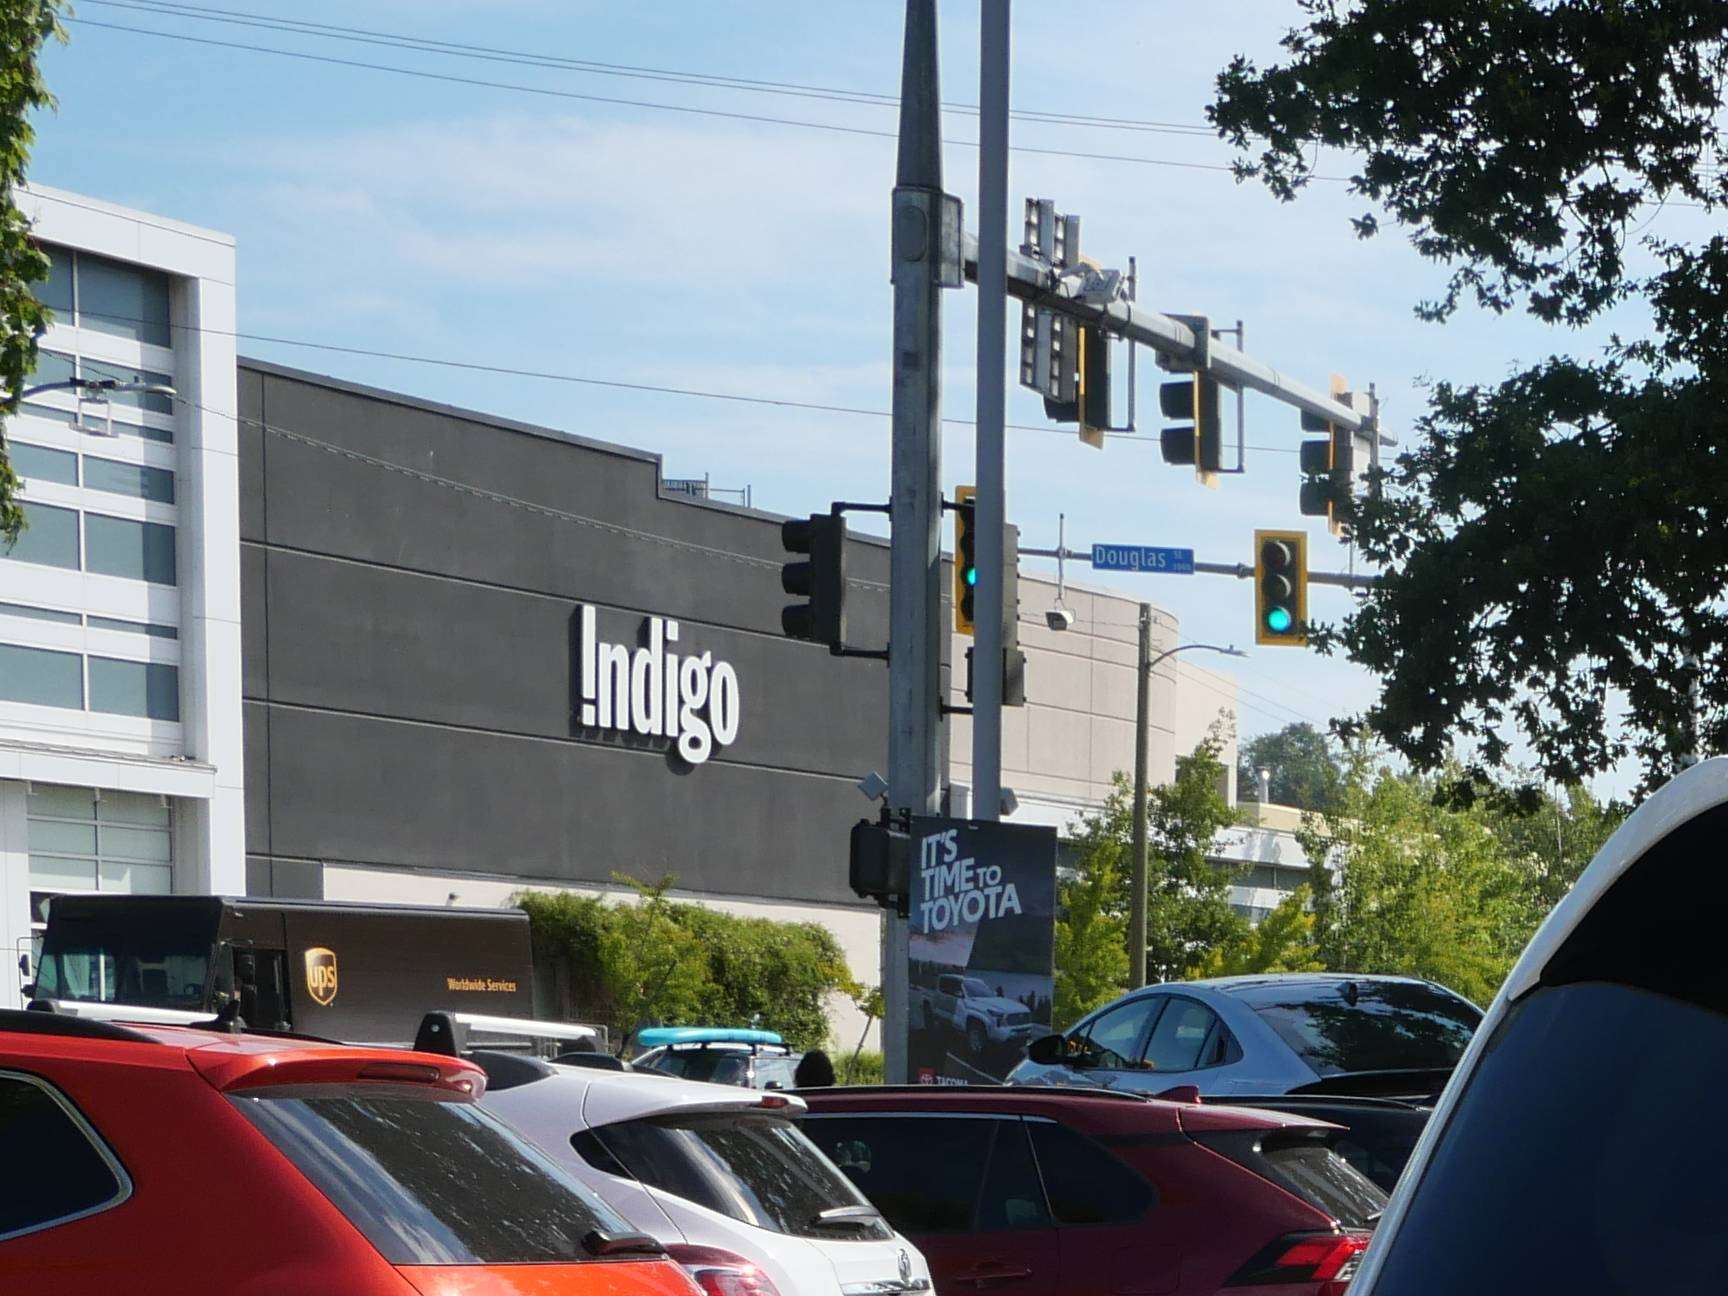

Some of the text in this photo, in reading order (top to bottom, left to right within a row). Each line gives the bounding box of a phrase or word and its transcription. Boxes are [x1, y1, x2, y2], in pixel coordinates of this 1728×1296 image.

[1095, 546, 1166, 569] Douglas
[582, 604, 739, 763] Indigo
[921, 829, 958, 869] IT'S
[921, 857, 1002, 900] TIME TO
[920, 883, 1022, 933] TOYOTA
[309, 965, 335, 996] ups
[447, 977, 516, 992] Worldwide Services
